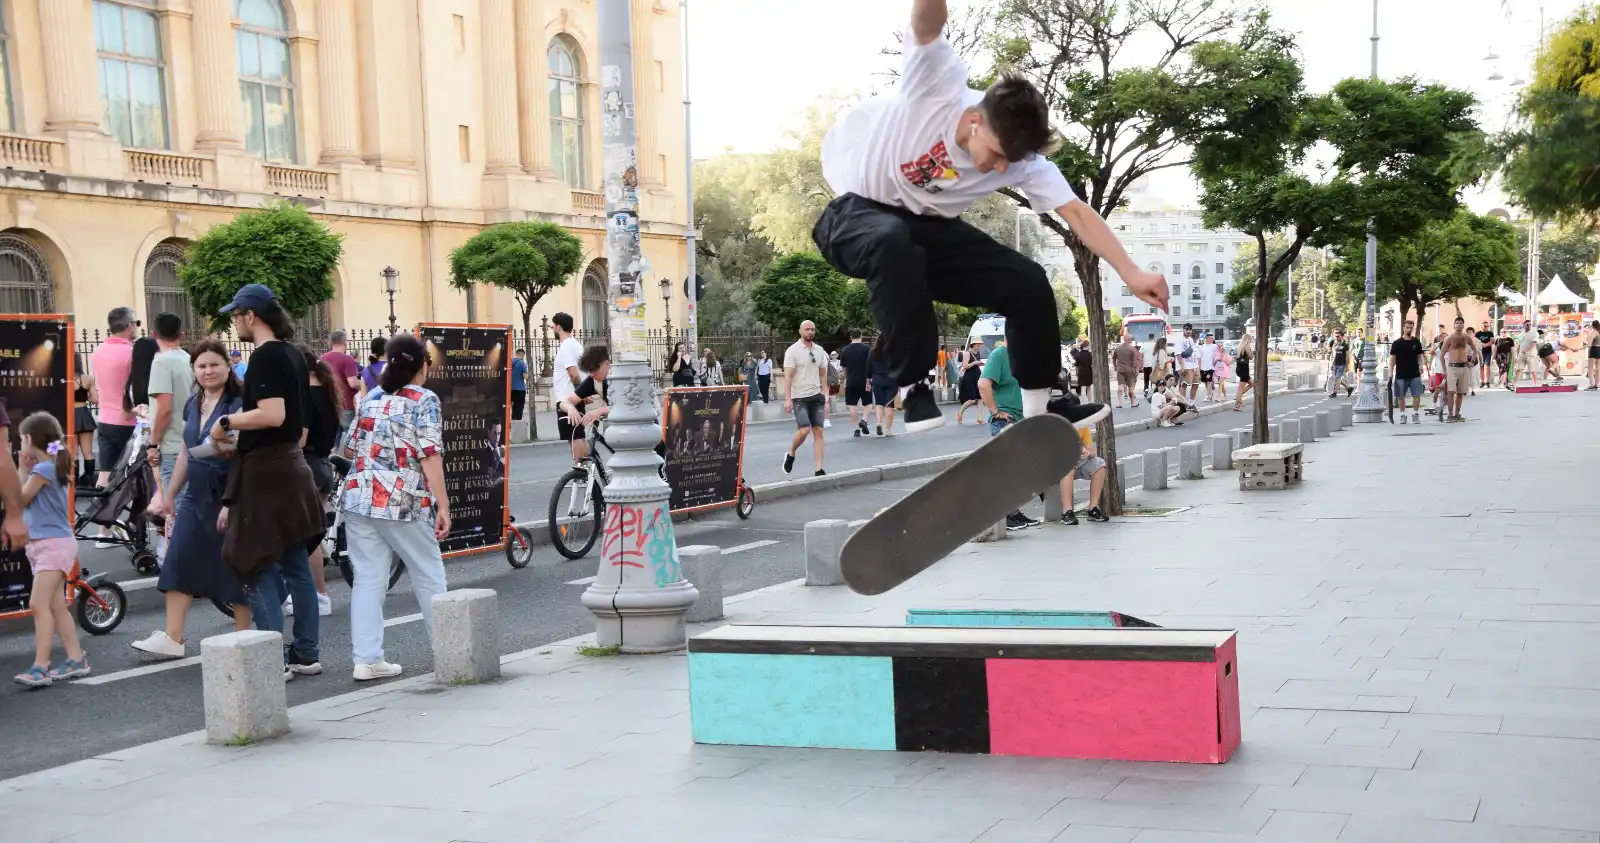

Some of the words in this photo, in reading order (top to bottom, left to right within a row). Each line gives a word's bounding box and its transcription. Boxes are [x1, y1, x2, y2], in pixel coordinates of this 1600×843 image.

[443, 419, 485, 431] BOCELLI
[445, 440, 488, 452] ARRERAS
[446, 460, 480, 473] VERTIS
